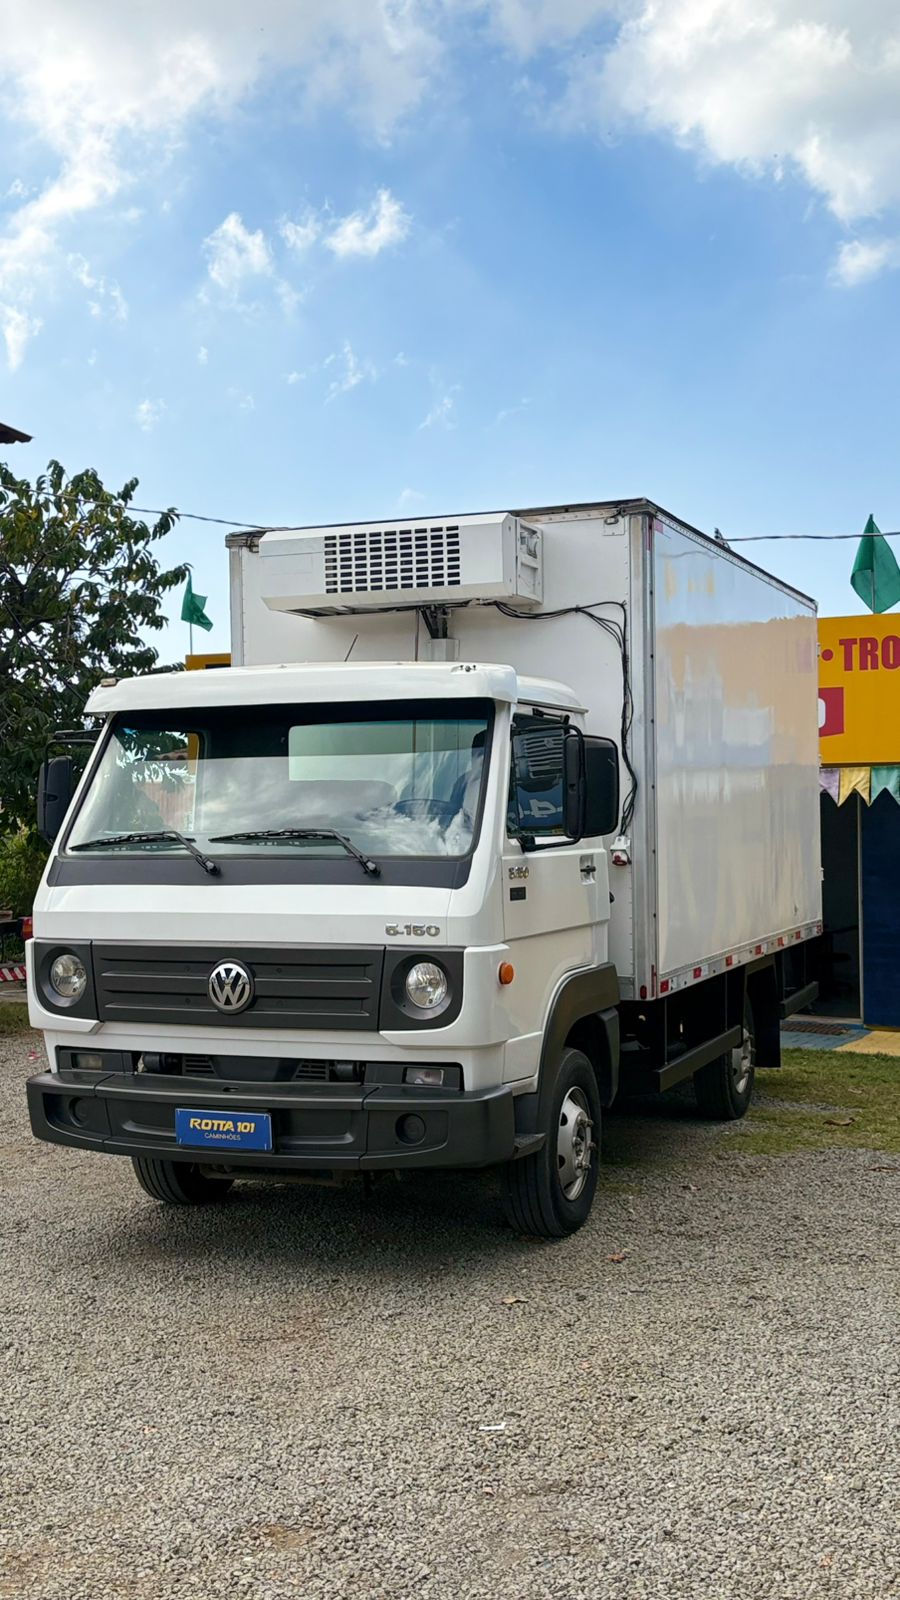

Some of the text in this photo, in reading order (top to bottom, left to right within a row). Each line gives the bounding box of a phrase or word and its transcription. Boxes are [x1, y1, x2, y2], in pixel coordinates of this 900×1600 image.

[209, 962, 251, 1011] VW
[189, 1118, 256, 1133] ROTTA 101
[204, 1132, 241, 1141] CAMINHÕES
